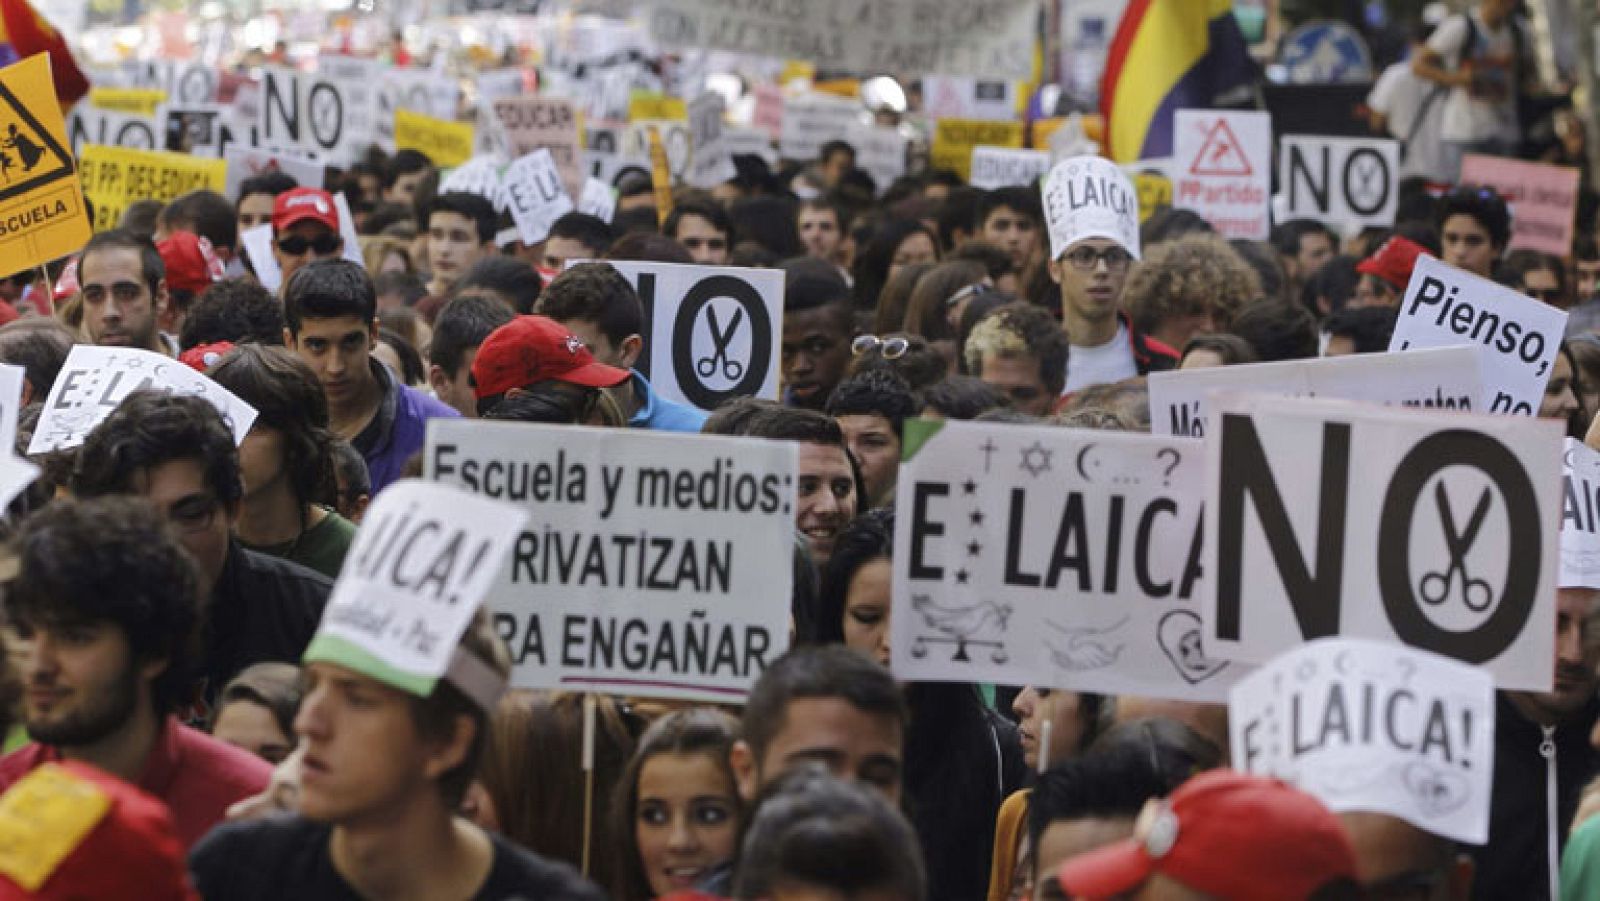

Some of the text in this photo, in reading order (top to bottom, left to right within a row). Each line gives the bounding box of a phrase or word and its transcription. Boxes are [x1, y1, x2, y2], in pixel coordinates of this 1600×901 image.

[264, 72, 343, 150] NO
[0, 200, 68, 236] SCUELA
[1290, 145, 1389, 216] NO
[1408, 275, 1549, 377] Pienso,
[433, 443, 792, 520] Escuela y medios:
[511, 522, 732, 594] RIVATIZAN
[1215, 412, 1543, 666] NO
[560, 610, 770, 676] ENGAÑAR
[1291, 680, 1474, 769] LAICA!
